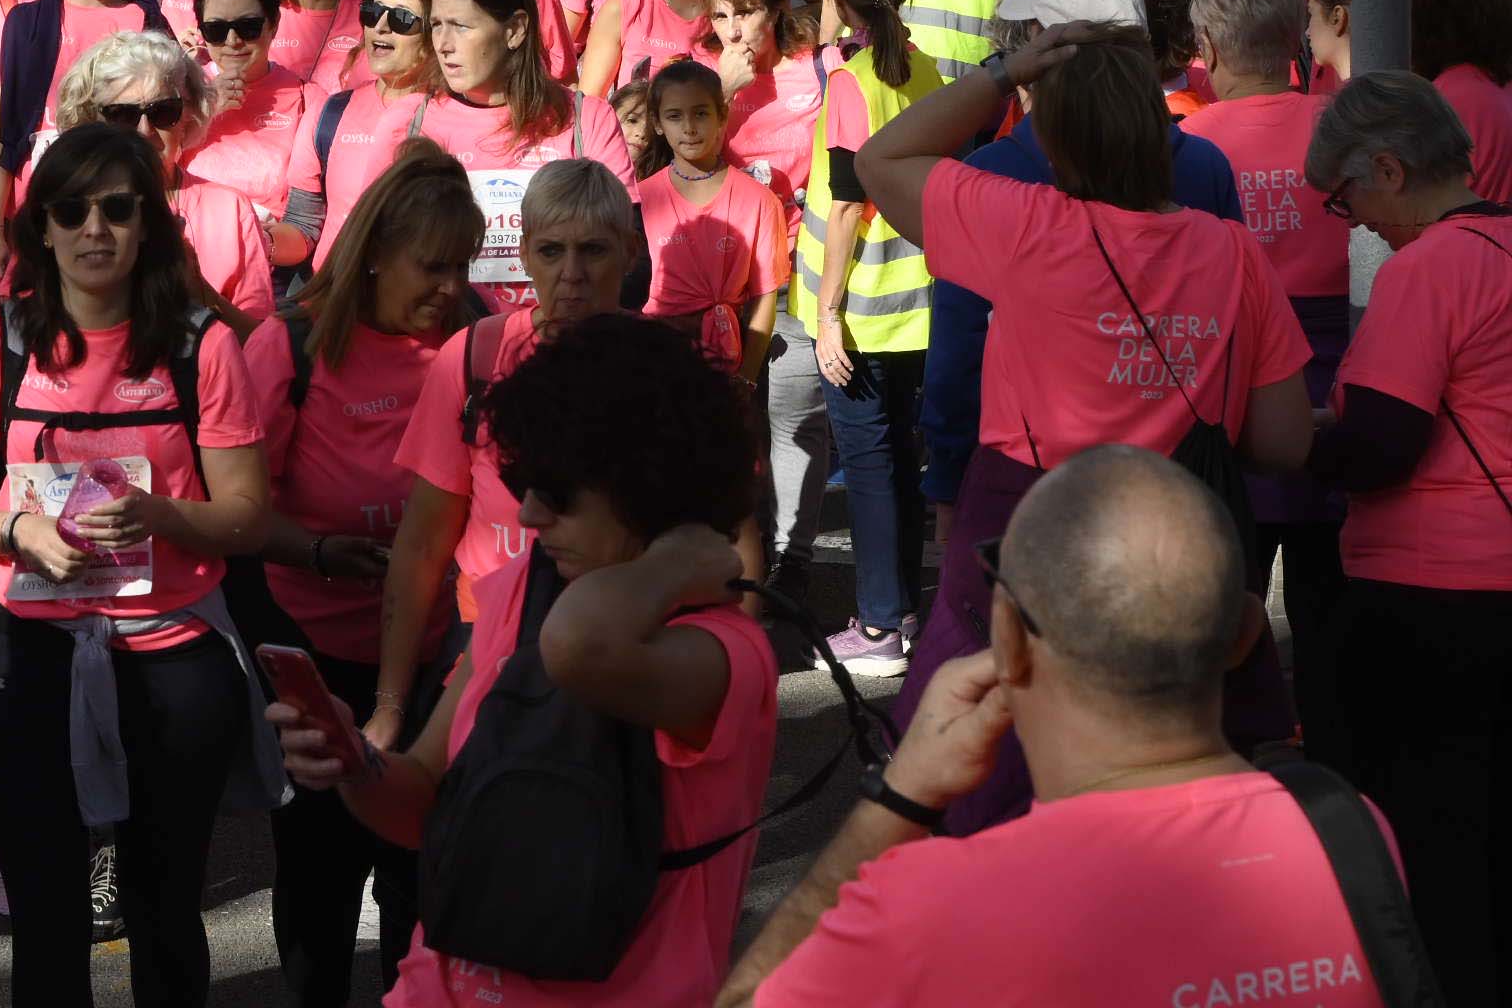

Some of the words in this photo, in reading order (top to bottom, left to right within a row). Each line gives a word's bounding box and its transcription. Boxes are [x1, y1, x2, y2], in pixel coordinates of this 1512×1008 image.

[1245, 192, 1256, 211] E
[1268, 192, 1297, 209] LA
[1247, 211, 1303, 233] UJER
[1097, 312, 1221, 338] CARRERA
[1119, 338, 1153, 362] DE
[1165, 339, 1196, 363] LA
[22, 374, 69, 392] YSHO
[1108, 363, 1200, 389] MUJER
[491, 523, 526, 558] TU
[1172, 953, 1364, 1008] CARRERA
